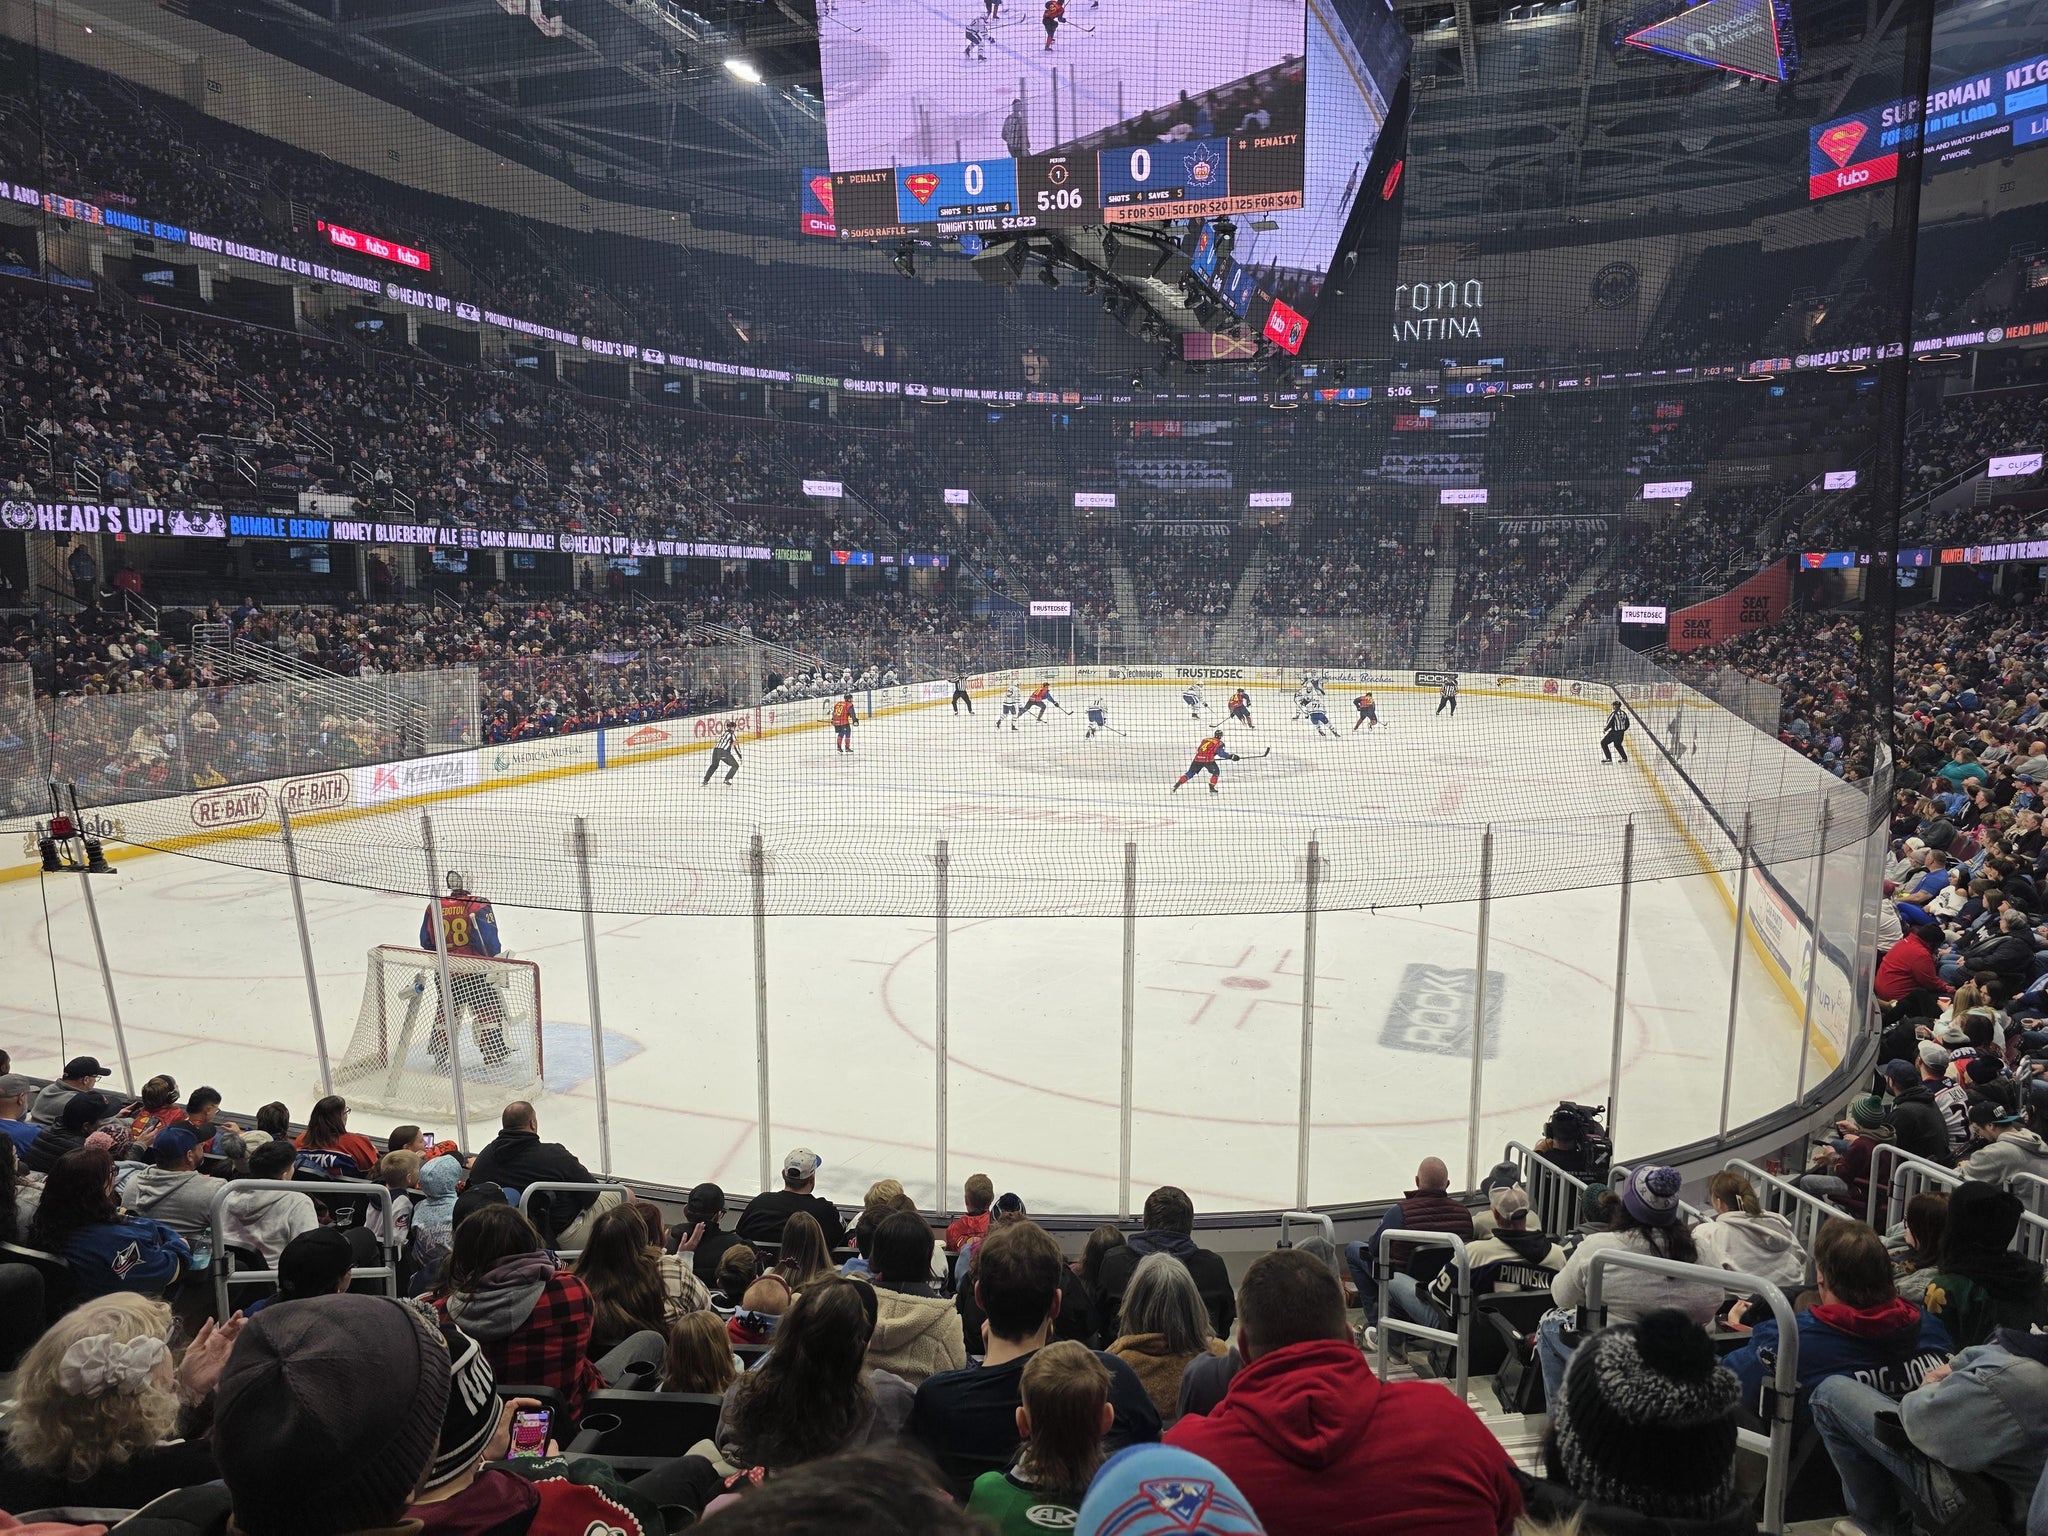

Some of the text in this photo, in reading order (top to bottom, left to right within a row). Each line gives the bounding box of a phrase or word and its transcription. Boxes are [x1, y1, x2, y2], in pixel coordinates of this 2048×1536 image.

[1961, 102, 1997, 125] LAND
[1255, 134, 1297, 148] PENALTY
[1950, 135, 1975, 146] WATCH
[1130, 149, 1151, 181] 0
[850, 173, 887, 184] PENALTY
[965, 164, 983, 195] 0
[1837, 169, 1869, 187] fubo
[1037, 188, 1082, 211] 5:06
[1108, 189, 1183, 203] SHOTS 4 SAVES 5
[1236, 195, 1297, 209] 125 FOR $40
[940, 203, 1010, 216] SHOTS 5 SAVES 4
[1120, 206, 1166, 219] 5 FOR $10
[1173, 201, 1228, 215] 50 FOR $20
[851, 226, 906, 238] 50/50 RAFFLE
[937, 216, 1037, 233] TONIGHT'S TOTAL $2,623
[14, 184, 381, 294] AND BUMBLE BERRY HONEY BLUEBERRY ALE ON THE CONCOURSE!
[331, 227, 356, 247] fubo
[365, 237, 389, 257] fubo
[397, 248, 420, 266] fubo
[400, 287, 451, 313] HEAD'S UP!
[592, 339, 638, 358] HEAD'S UP!
[1809, 350, 1850, 367] HEAD'S
[1852, 347, 1871, 362] UP!
[1913, 331, 1984, 353] AWARD-WINNING
[2006, 324, 2030, 339] HEAD
[704, 360, 739, 375] NORTHEAST
[757, 368, 790, 382] LOCATIONS
[854, 380, 901, 394] HEAD'S UP!
[1387, 386, 1412, 397] 5:06
[37, 504, 555, 550] HEAD'S UP! BUMBLE BERRY HONEY BLUEBERRY ALE CANS AVAILABLE!
[574, 536, 611, 554] HEAD'S
[612, 537, 629, 554] UP!
[657, 541, 675, 555] VISIT
[676, 542, 689, 556] OUR
[695, 543, 728, 558] NORTHEAST
[1742, 596, 1770, 609] SEAT
[1625, 611, 1662, 619] TRUSTEDSEC
[1740, 610, 1769, 623] GEEK
[1683, 619, 1712, 629] SEAT
[1682, 629, 1712, 640] GEEK
[1175, 668, 1243, 679] TRUSTEDSEC
[403, 760, 464, 786] KENDA
[442, 906, 465, 916] EDOTOV
[1500, 1265, 1549, 1288] PIWINSKI
[1900, 1353, 1944, 1391] JOHN
